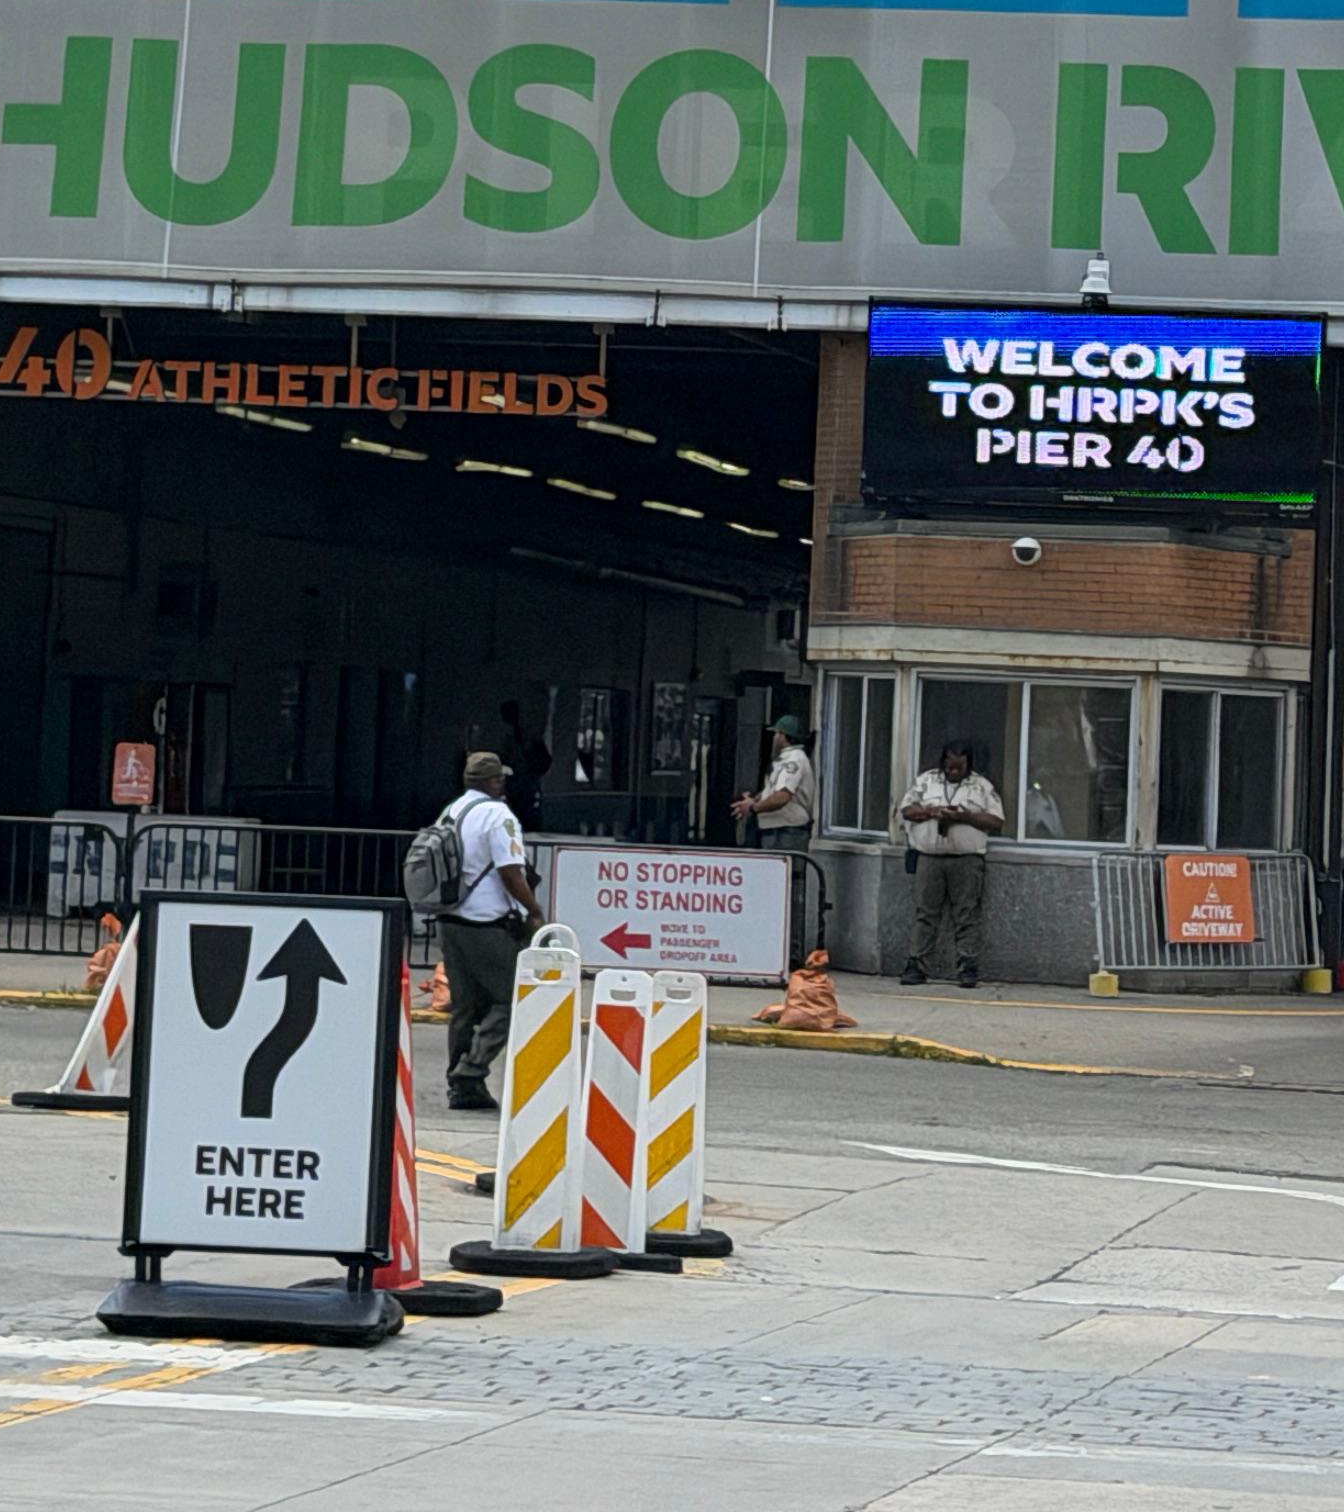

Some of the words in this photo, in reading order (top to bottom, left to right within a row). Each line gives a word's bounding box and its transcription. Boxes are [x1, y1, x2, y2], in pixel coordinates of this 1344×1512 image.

[942, 338, 1245, 384] WELCOME
[128, 359, 399, 408] ATHLETIC
[417, 369, 608, 417] FIELDS
[928, 380, 1014, 421] TO
[1029, 384, 1255, 430] HRPK'S
[976, 427, 1112, 469] PIER
[1126, 435, 1205, 473] 40
[597, 861, 629, 881] NO
[636, 863, 743, 886] STOPPING
[597, 889, 628, 909] OR
[635, 890, 743, 914] STANDING
[1191, 904, 1234, 920] ACTIVE
[692, 924, 706, 935] TO
[1181, 921, 1244, 937] DRIVEWAY
[660, 937, 720, 949] PASSENGER
[709, 953, 738, 964] AREA
[195, 1145, 320, 1181] ENTER
[204, 1185, 306, 1221] HERE
